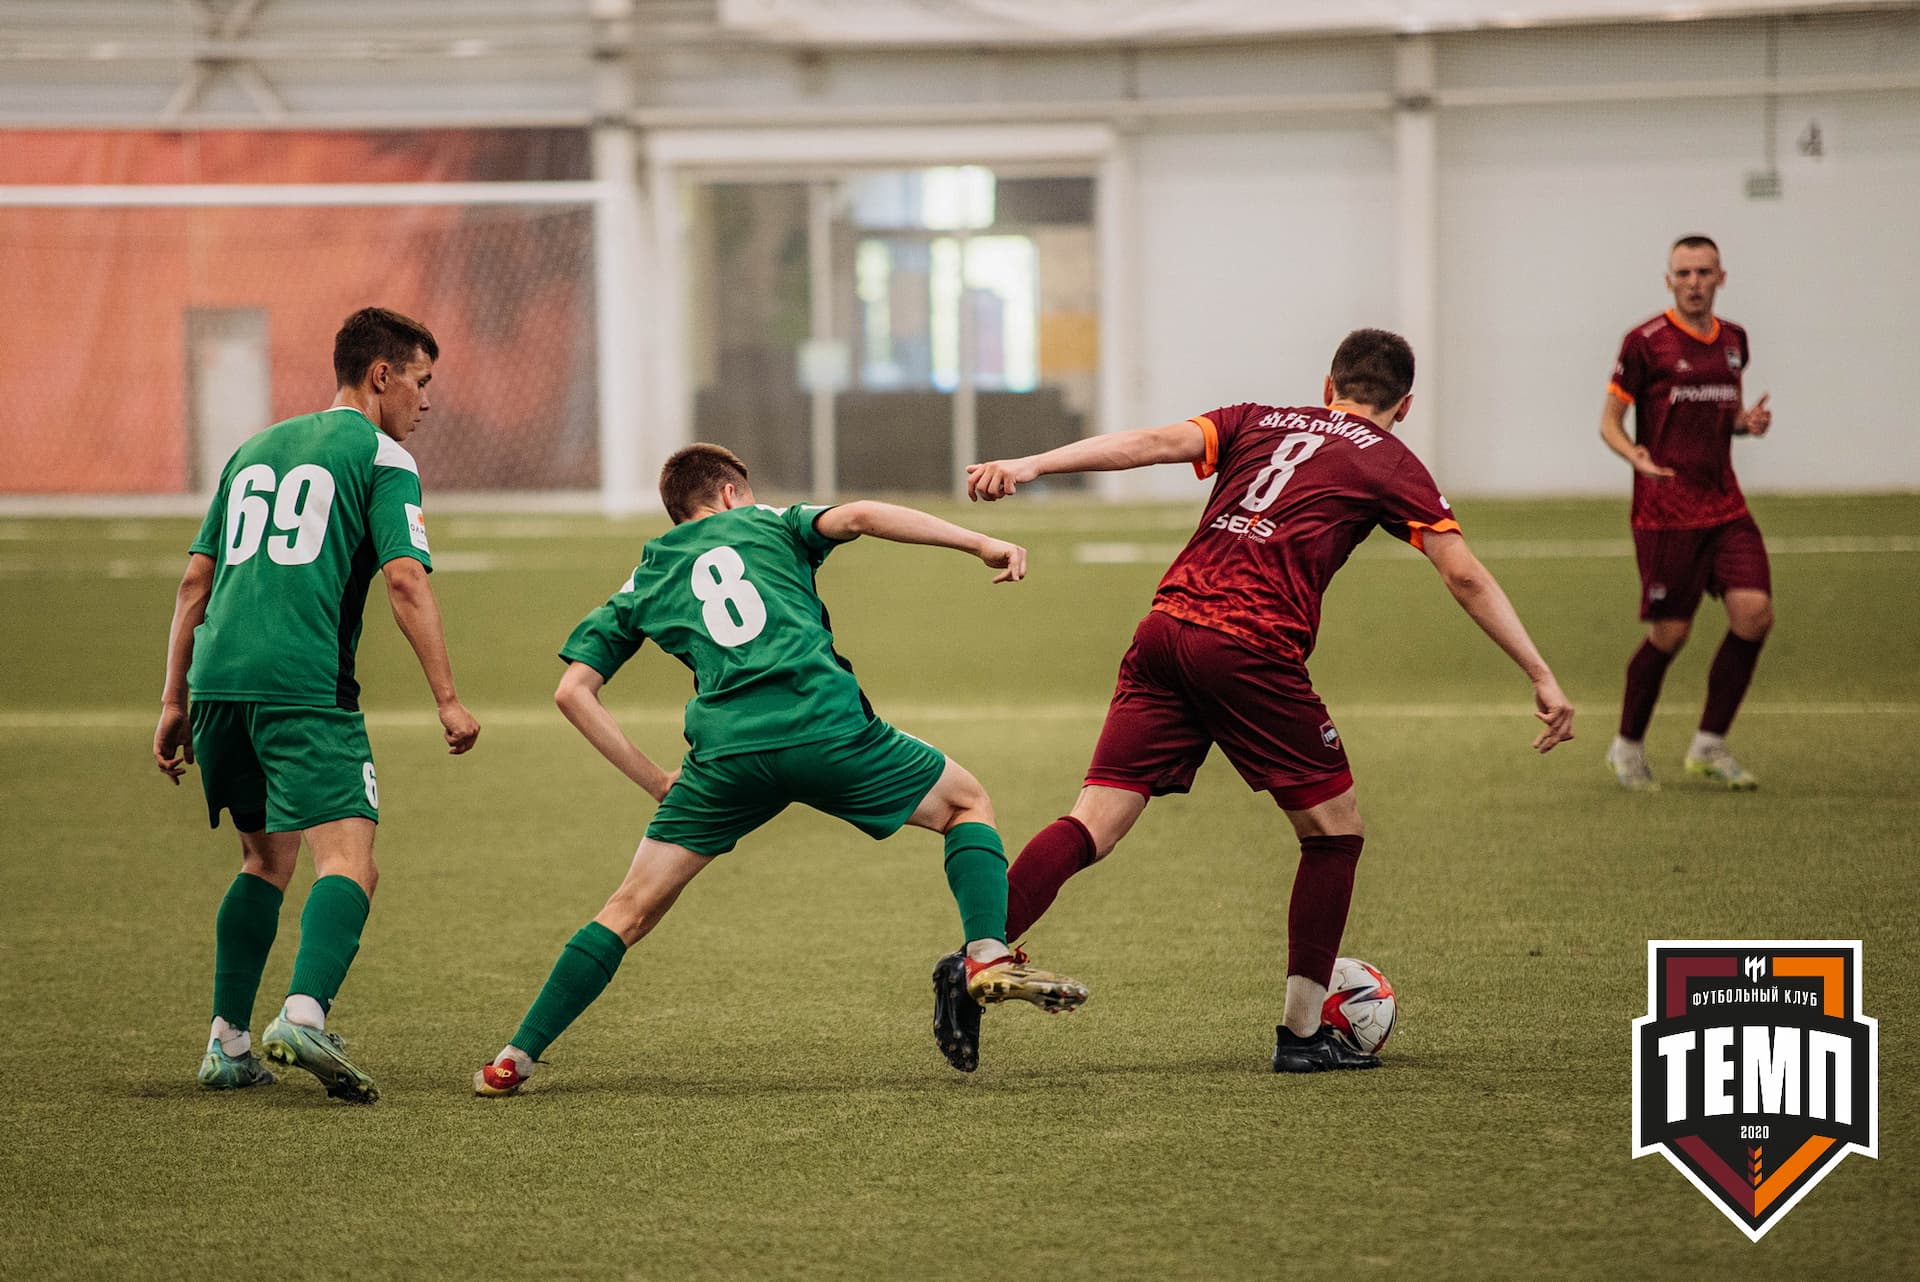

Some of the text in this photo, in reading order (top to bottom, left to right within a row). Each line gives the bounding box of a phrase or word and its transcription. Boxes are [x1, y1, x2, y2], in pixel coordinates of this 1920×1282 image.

[226, 463, 336, 566] 69
[1239, 431, 1325, 512] 8
[691, 545, 767, 647] 8
